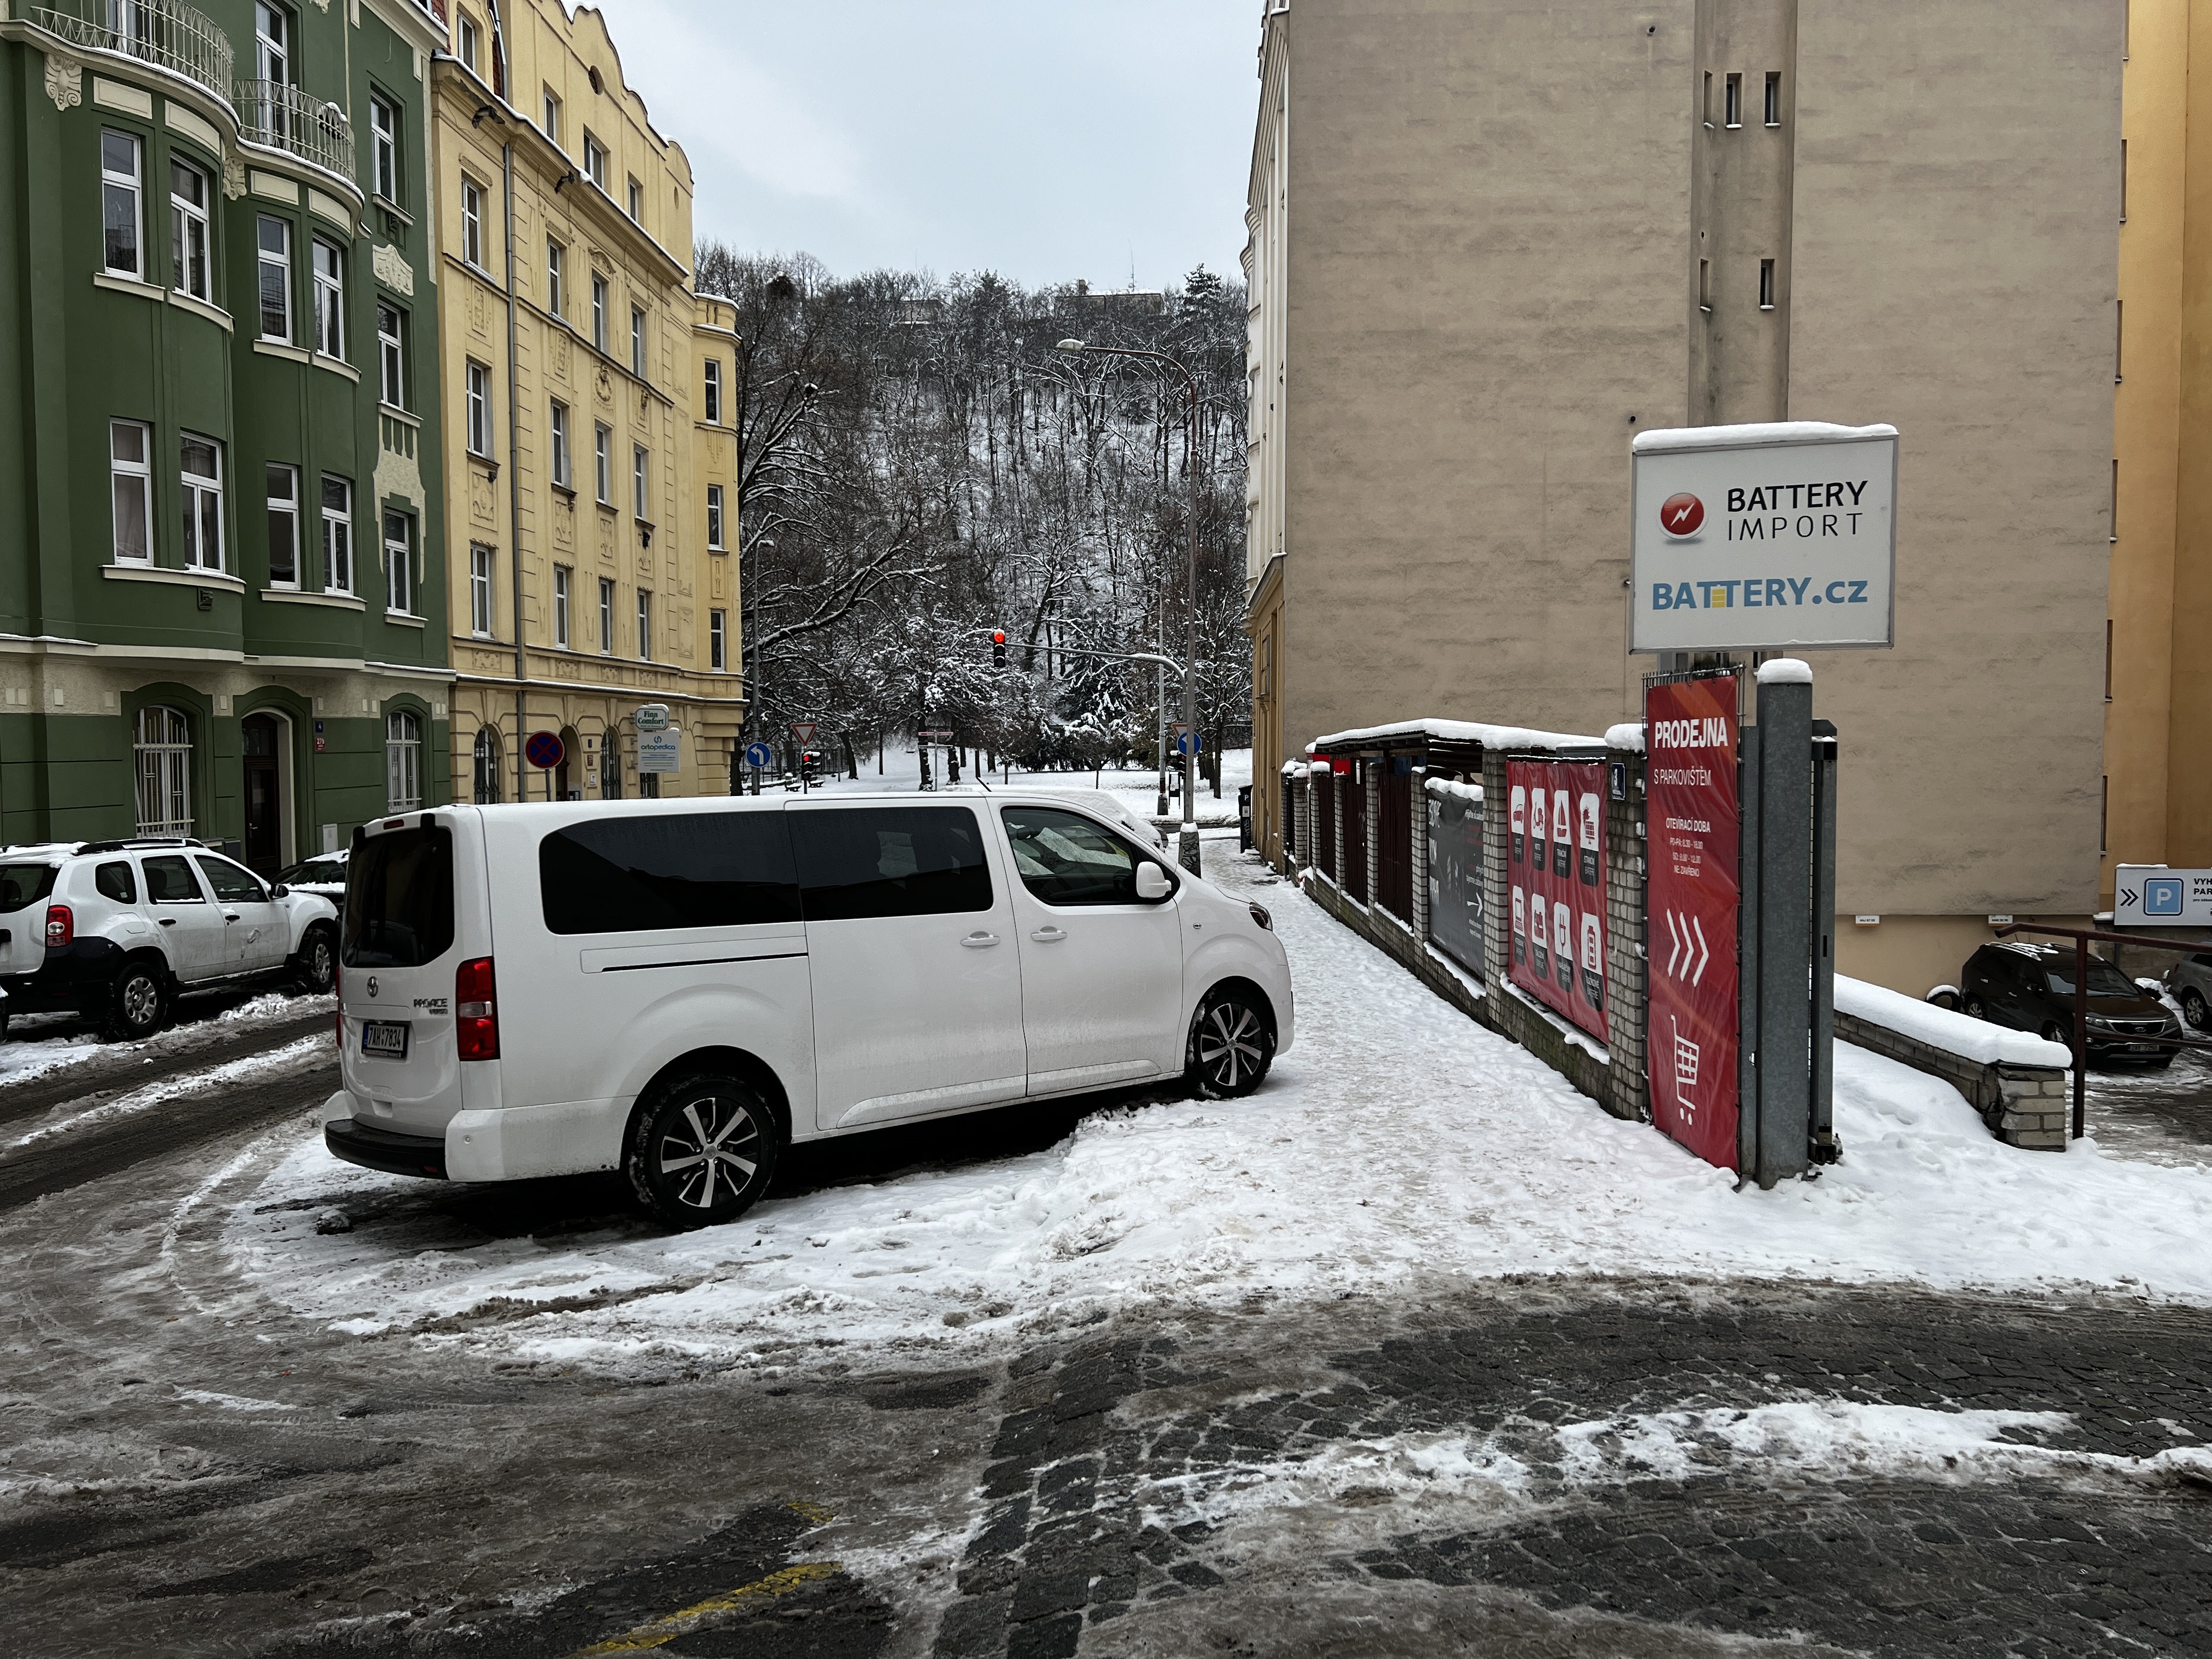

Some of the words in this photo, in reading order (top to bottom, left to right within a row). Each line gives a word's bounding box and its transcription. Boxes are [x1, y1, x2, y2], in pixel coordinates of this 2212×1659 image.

[1728, 481, 1868, 512] BATTERY
[1728, 512, 1863, 540] IMPORT
[1655, 717, 1728, 748] PRODEJNA
[1614, 768, 1618, 786] 3
[1654, 769, 1659, 785] S
[1660, 766, 1711, 786] PARKOVIŠTĚM
[1666, 816, 1693, 831] OTEVÍRACÍ
[1694, 821, 1711, 833] DOBA
[2157, 888, 2172, 906] P
[368, 1027, 381, 1046] 7AH
[384, 1028, 402, 1048] 7834
